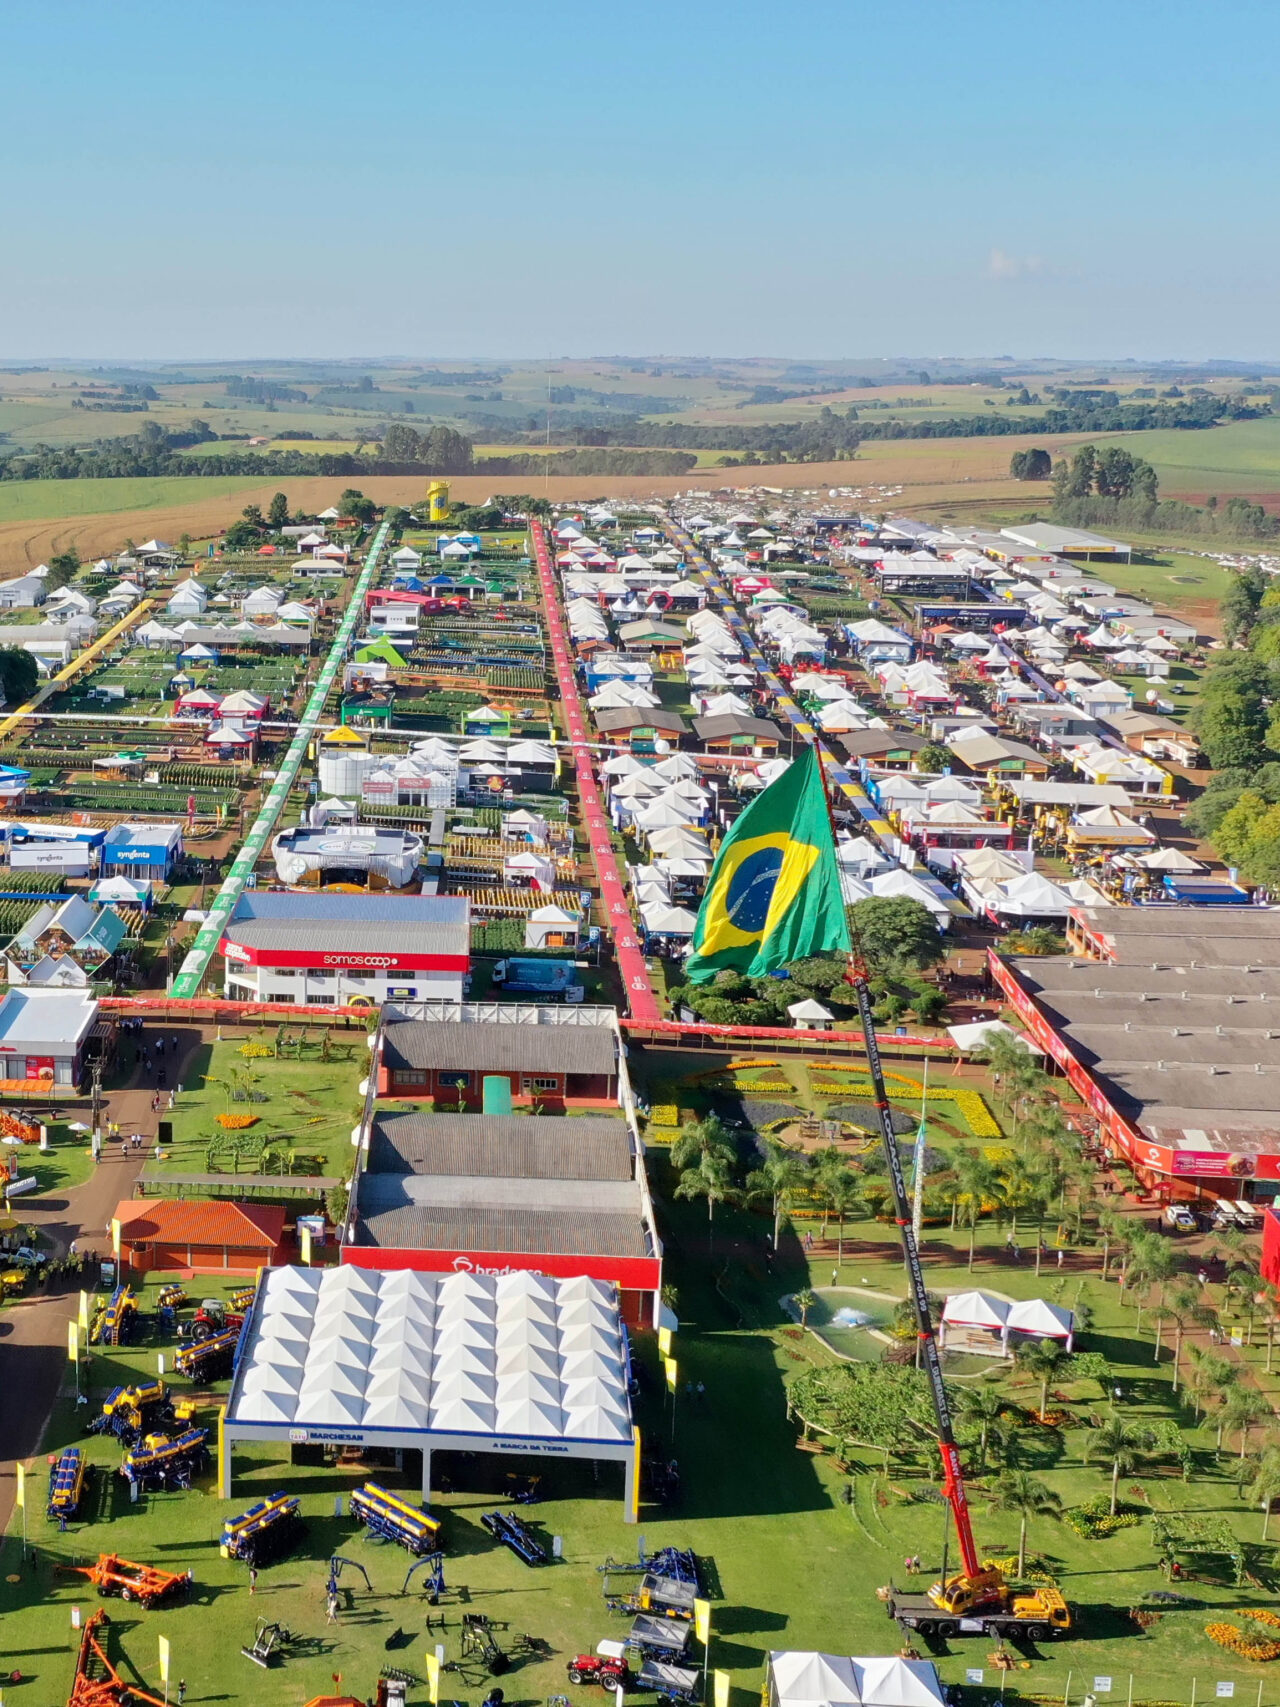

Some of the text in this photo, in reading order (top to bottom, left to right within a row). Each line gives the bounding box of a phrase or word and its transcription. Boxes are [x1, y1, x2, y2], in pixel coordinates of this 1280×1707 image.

[36, 855, 63, 863] syngenta
[117, 849, 150, 860] syngenta
[882, 1109, 905, 1199] LOCAÇÃO
[475, 1264, 542, 1276] bradeo
[927, 1344, 949, 1428] BW GUINDASTES
[309, 1433, 363, 1441] MARCHESAN
[949, 1450, 960, 1477] SANY
